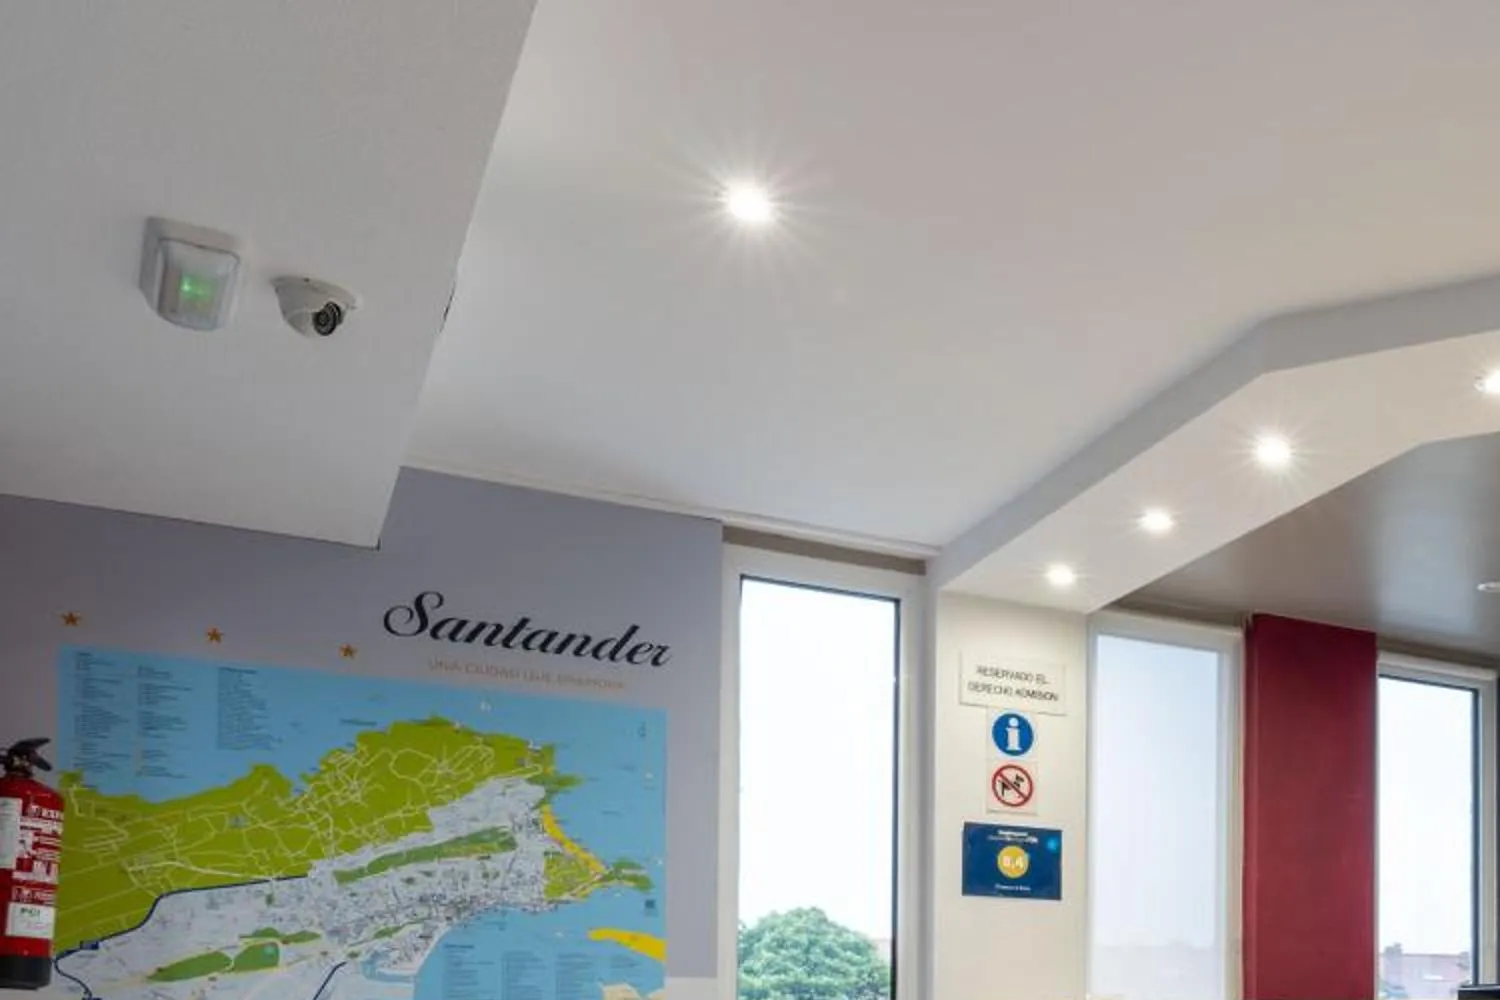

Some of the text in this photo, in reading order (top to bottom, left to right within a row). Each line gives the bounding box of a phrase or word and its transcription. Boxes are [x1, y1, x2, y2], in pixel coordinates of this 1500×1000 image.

[384, 590, 673, 667] Santander
[428, 658, 461, 673] UNA
[976, 665, 1034, 682] RESERVADO
